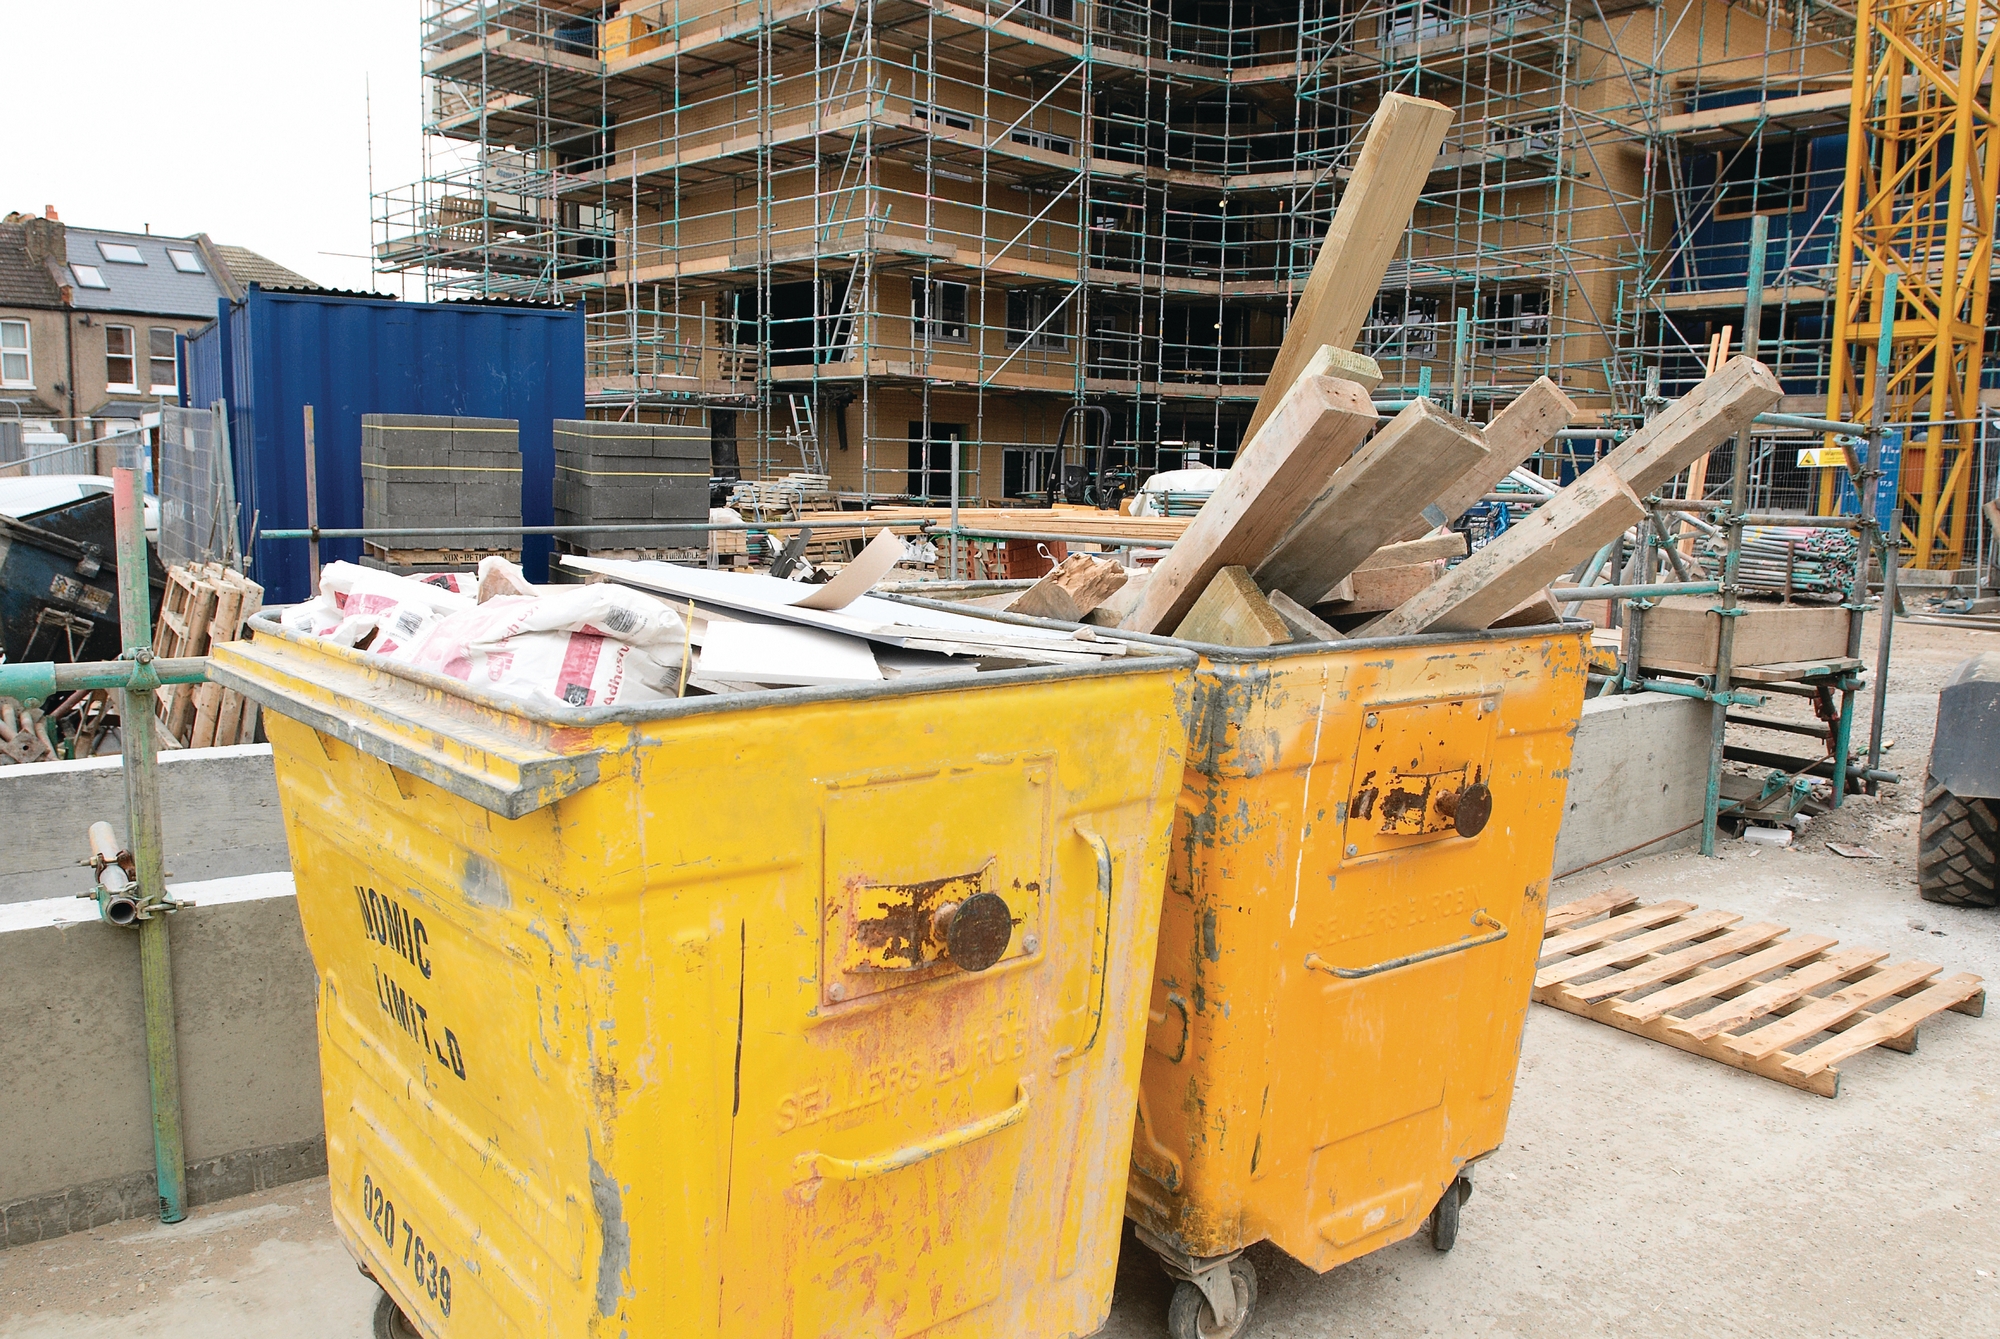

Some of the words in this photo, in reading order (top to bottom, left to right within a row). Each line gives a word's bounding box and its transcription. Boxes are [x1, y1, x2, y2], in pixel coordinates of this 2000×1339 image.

[603, 643, 632, 706] Adhesiv
[775, 1058, 923, 1134] SELLERS
[363, 1174, 395, 1249] 020
[402, 1218, 452, 1319] 7639
